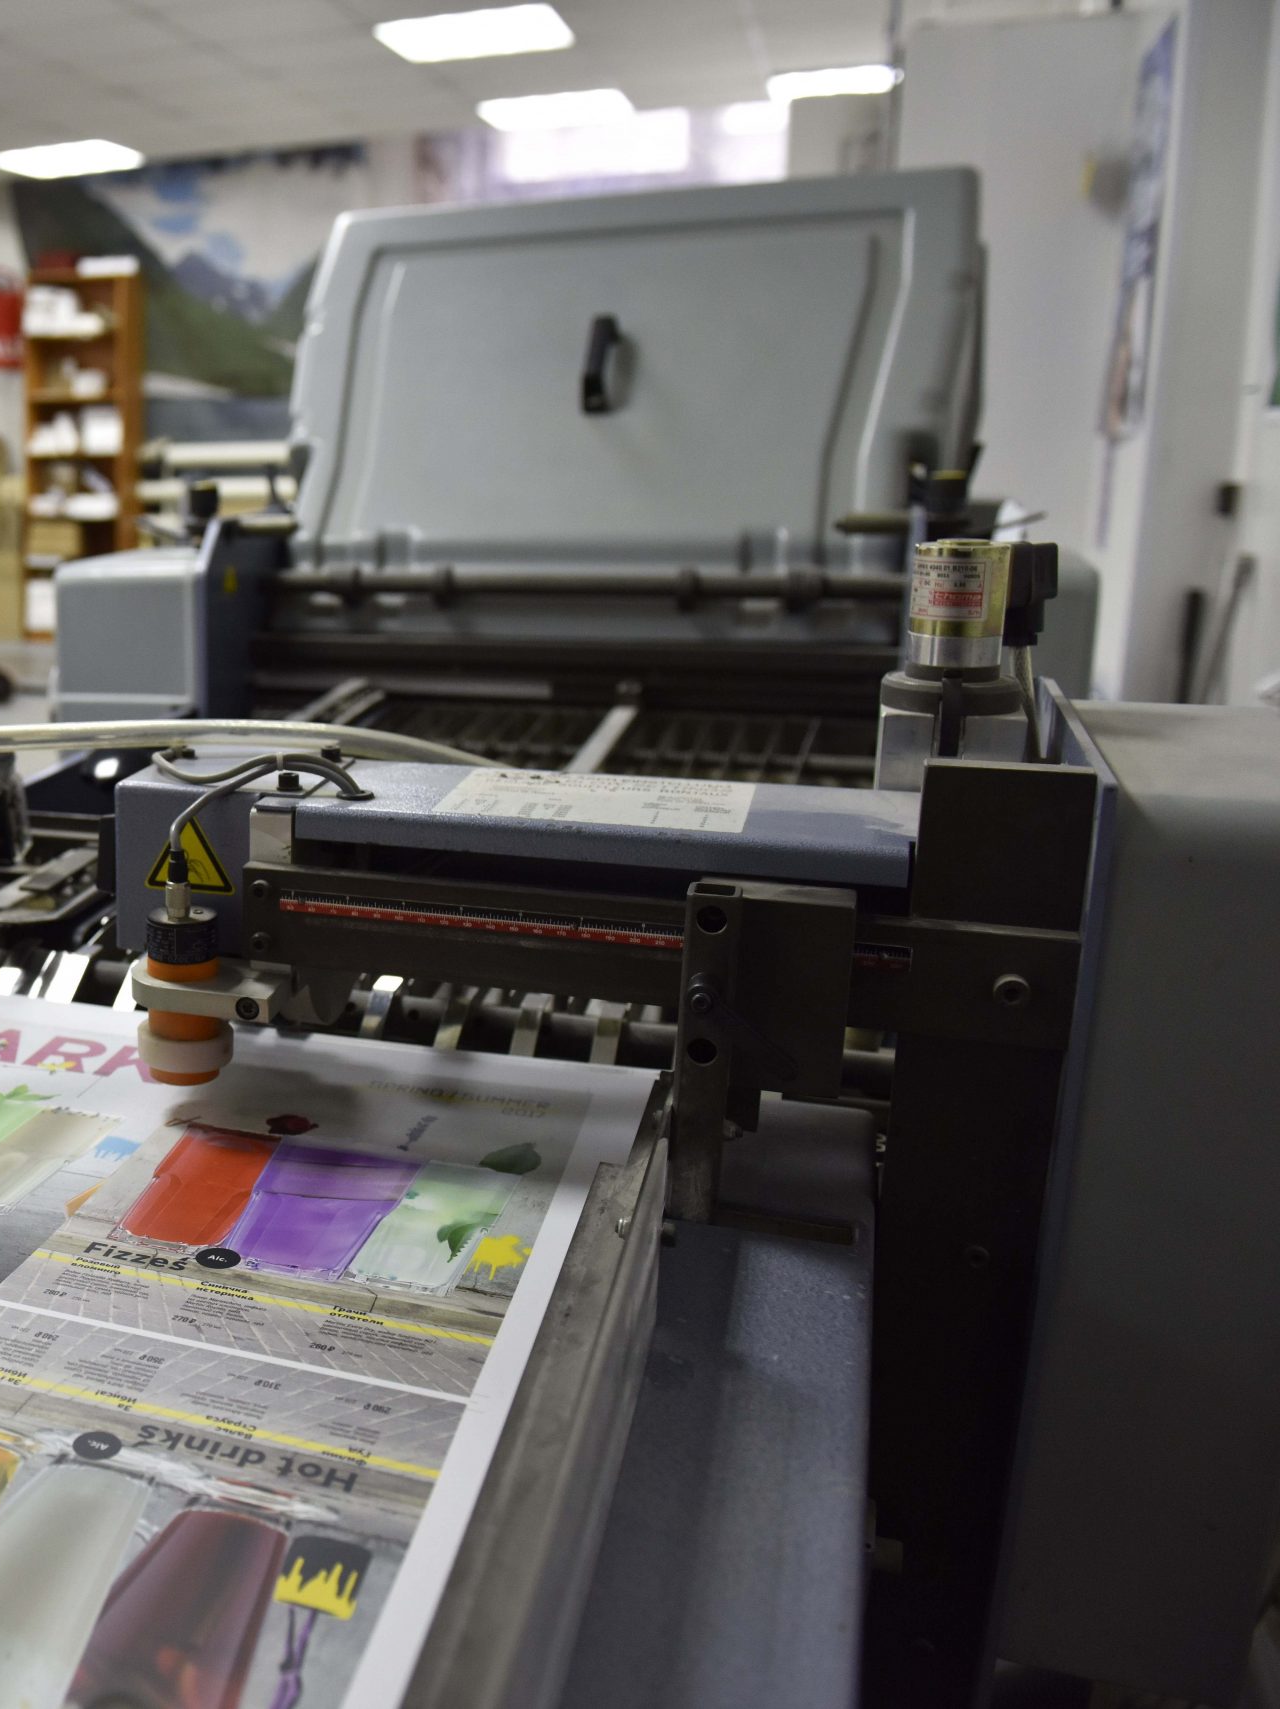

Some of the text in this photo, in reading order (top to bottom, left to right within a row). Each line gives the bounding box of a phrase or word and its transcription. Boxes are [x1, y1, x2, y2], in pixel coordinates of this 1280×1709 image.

[75, 1256, 121, 1269] Розовый
[207, 1254, 228, 1263] Alc.
[195, 1286, 254, 1301] истеричка
[200, 1281, 248, 1294] Синичка
[332, 1305, 367, 1316] Грачи
[329, 1311, 385, 1326] отлетели
[94, 1389, 138, 1405] Ибиса!
[117, 1403, 132, 1412] За
[205, 1414, 257, 1433] Страуса
[214, 1425, 253, 1441] Вальс
[87, 1439, 110, 1451] Alc.
[137, 1425, 358, 1493] Hot drinks
[348, 1446, 372, 1459] Гуд
